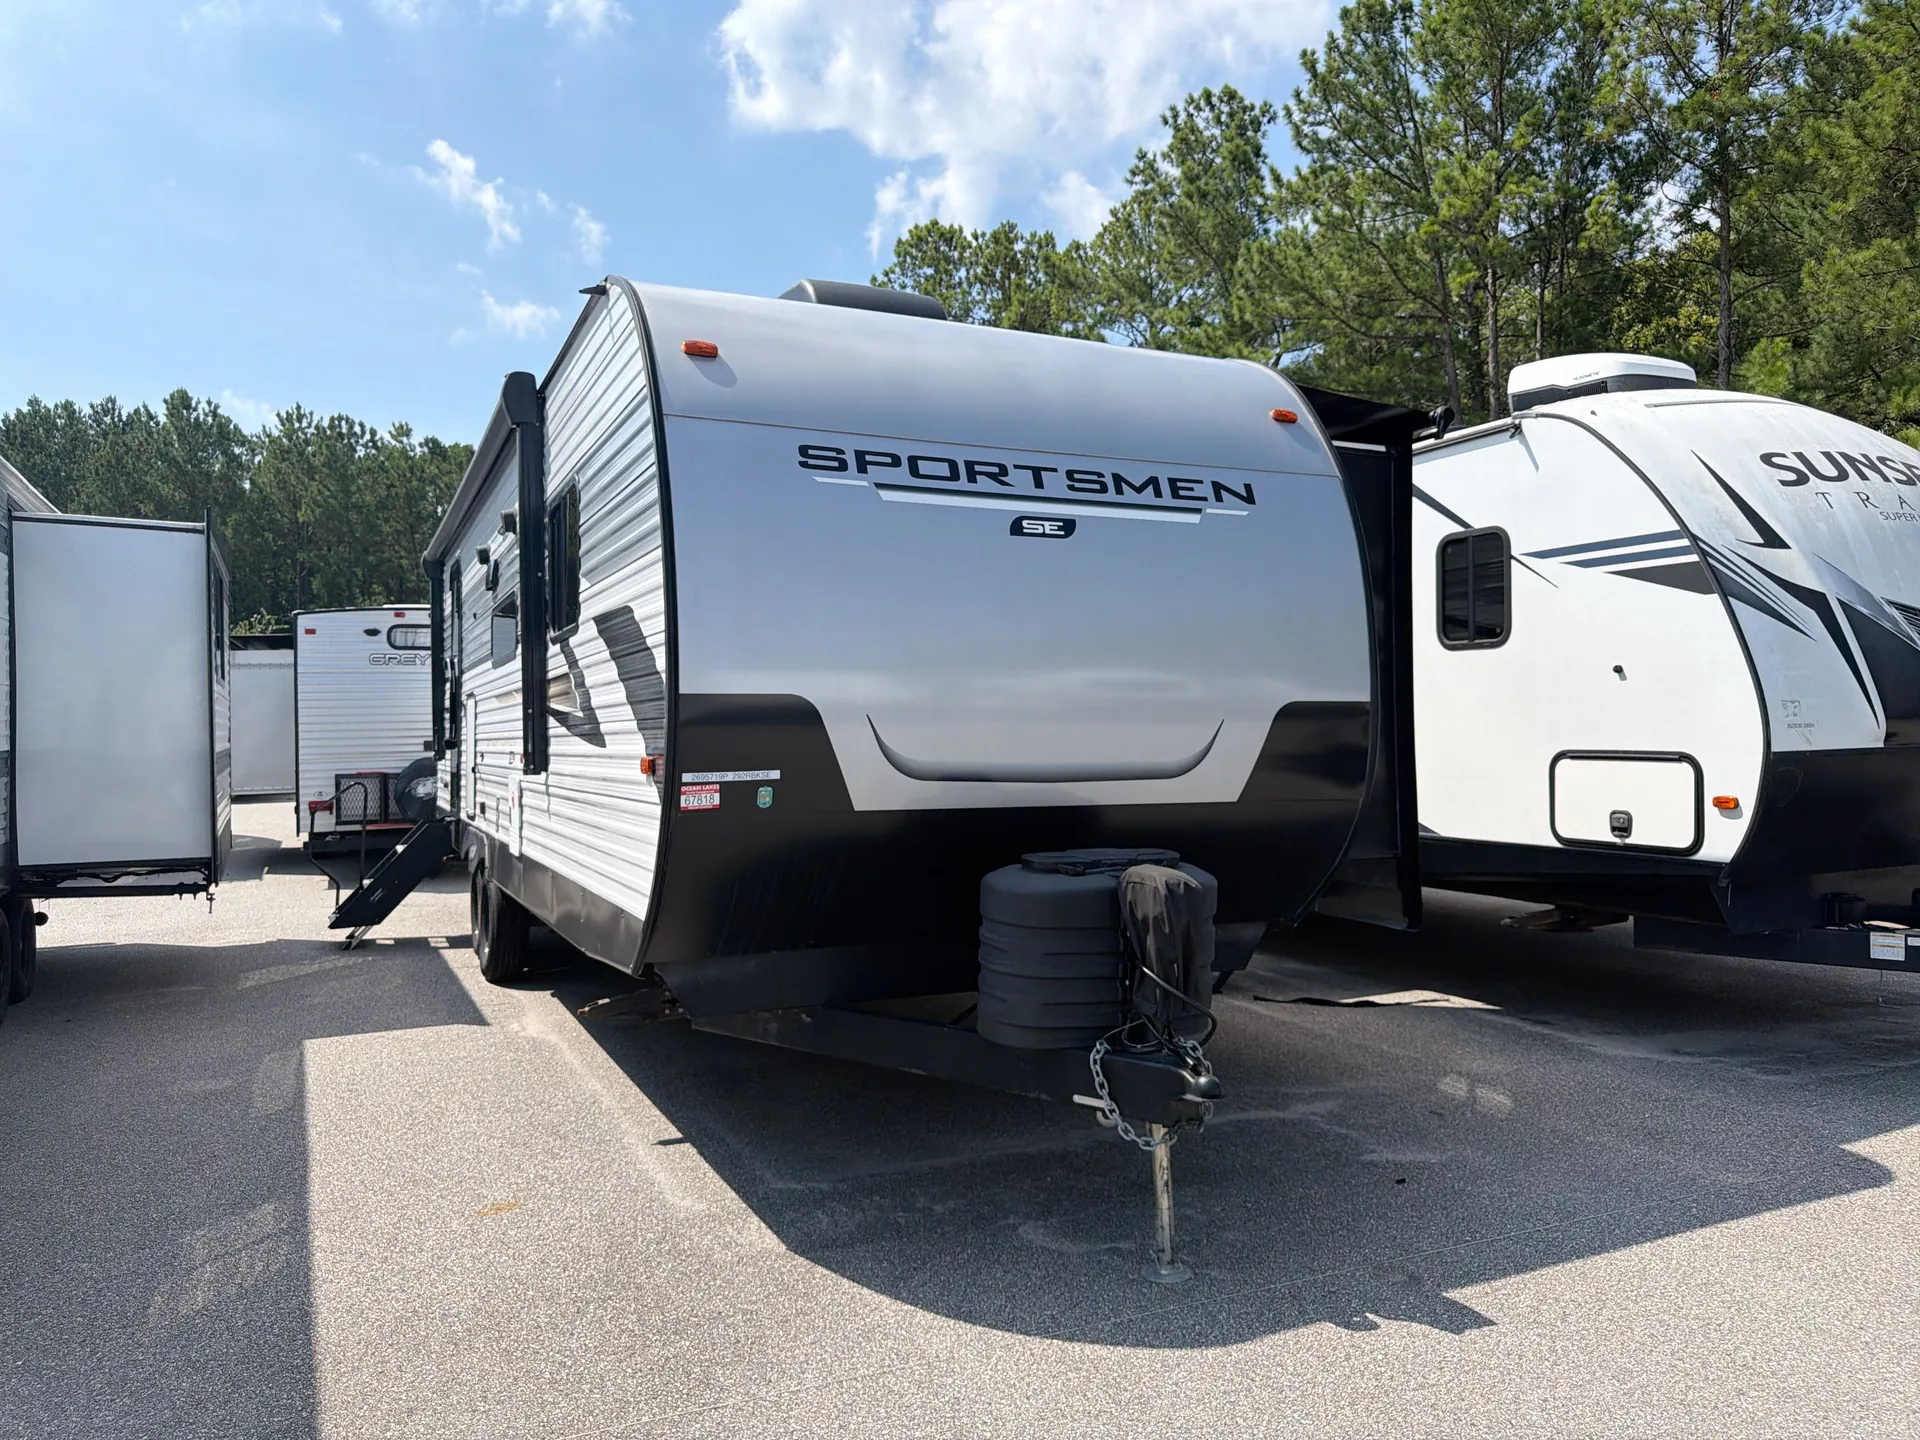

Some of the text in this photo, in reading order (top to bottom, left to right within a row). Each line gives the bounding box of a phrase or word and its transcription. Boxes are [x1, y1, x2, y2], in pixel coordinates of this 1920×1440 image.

[798, 444, 1257, 505] SPORTSMEN
[1880, 511, 1918, 522] SUPER
[1021, 519, 1066, 535] SE
[369, 653, 432, 666] GREY
[684, 793, 715, 806] 67818
